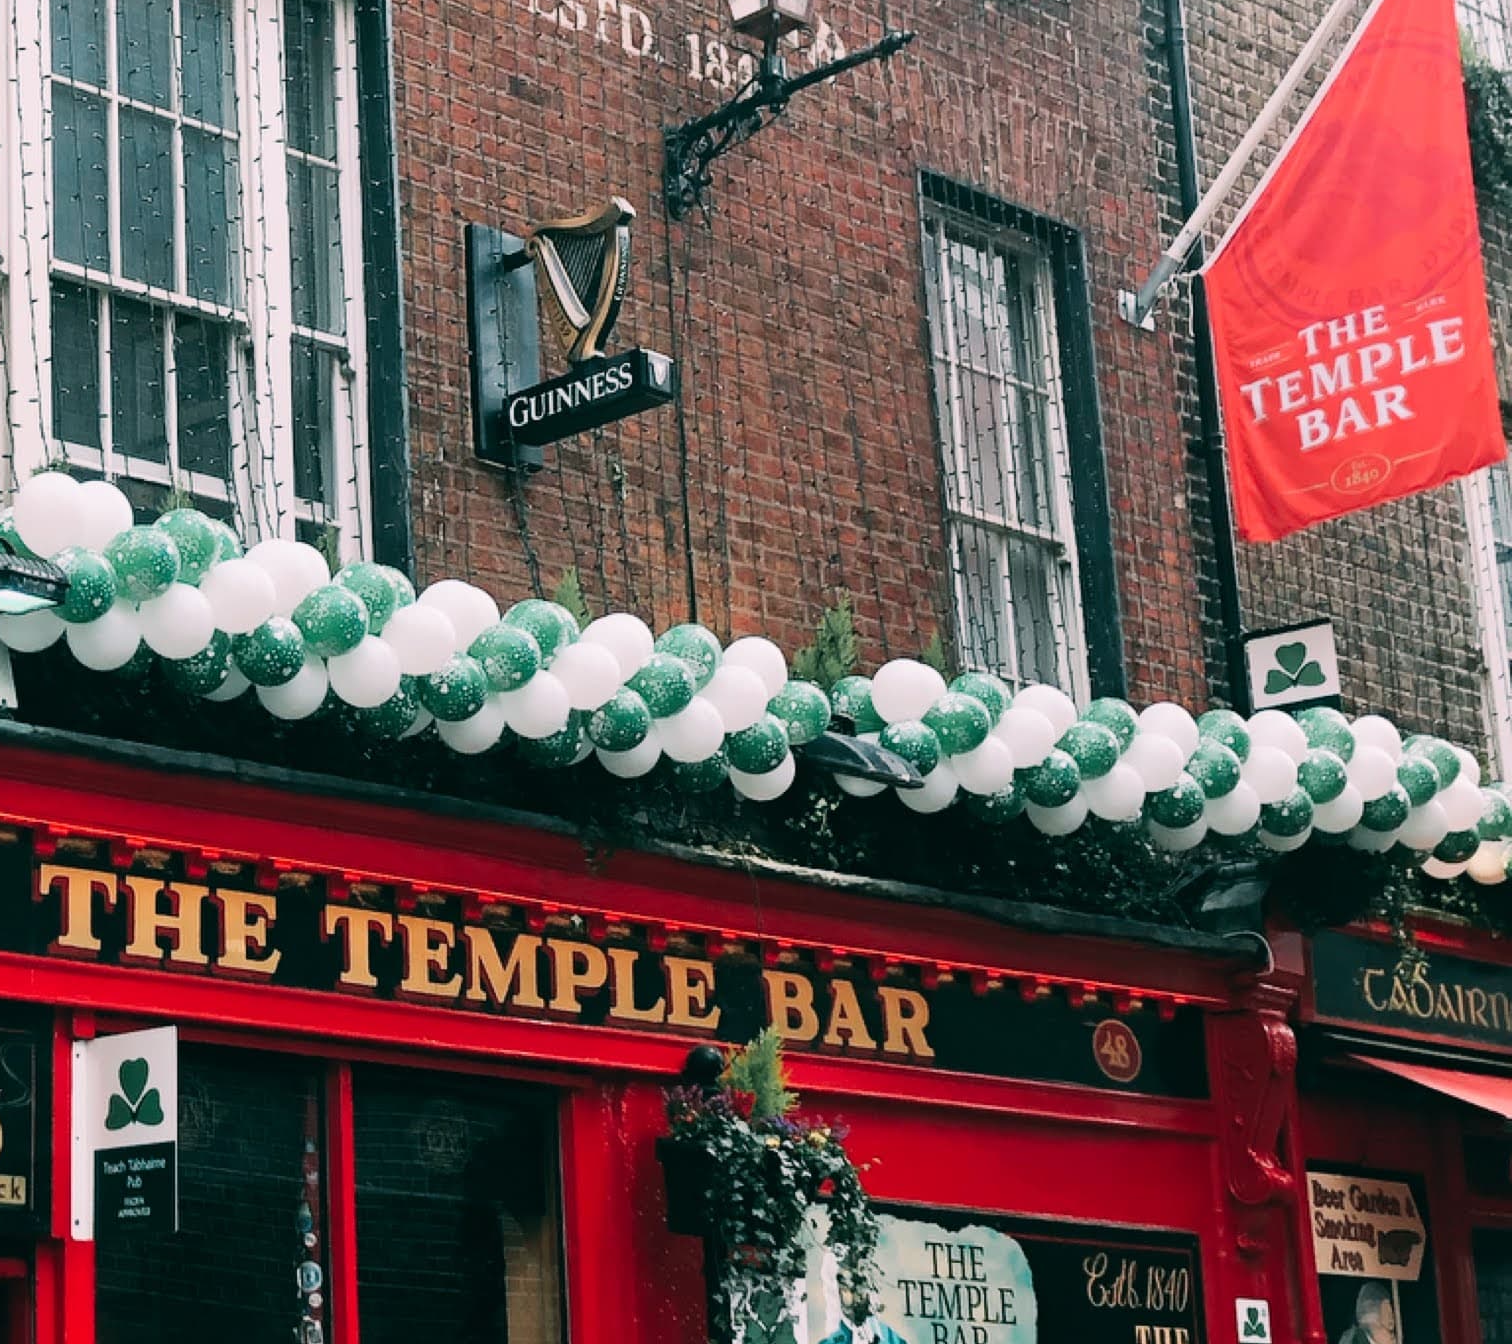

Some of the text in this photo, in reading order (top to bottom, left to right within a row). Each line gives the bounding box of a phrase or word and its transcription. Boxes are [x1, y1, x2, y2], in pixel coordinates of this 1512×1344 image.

[1297, 304, 1390, 357] THE
[1239, 316, 1466, 424] TEMPLE
[508, 361, 634, 429] GUINNESS
[1295, 384, 1416, 452] BAR
[33, 862, 936, 1058] THE TEMPLE BAR
[1101, 1031, 1131, 1066] 48
[1313, 1210, 1377, 1249] Smoking
[924, 1242, 988, 1284] THE
[1330, 1242, 1365, 1272] Area
[896, 1278, 1018, 1325] TEMPLE
[1146, 1267, 1189, 1313] 1840
